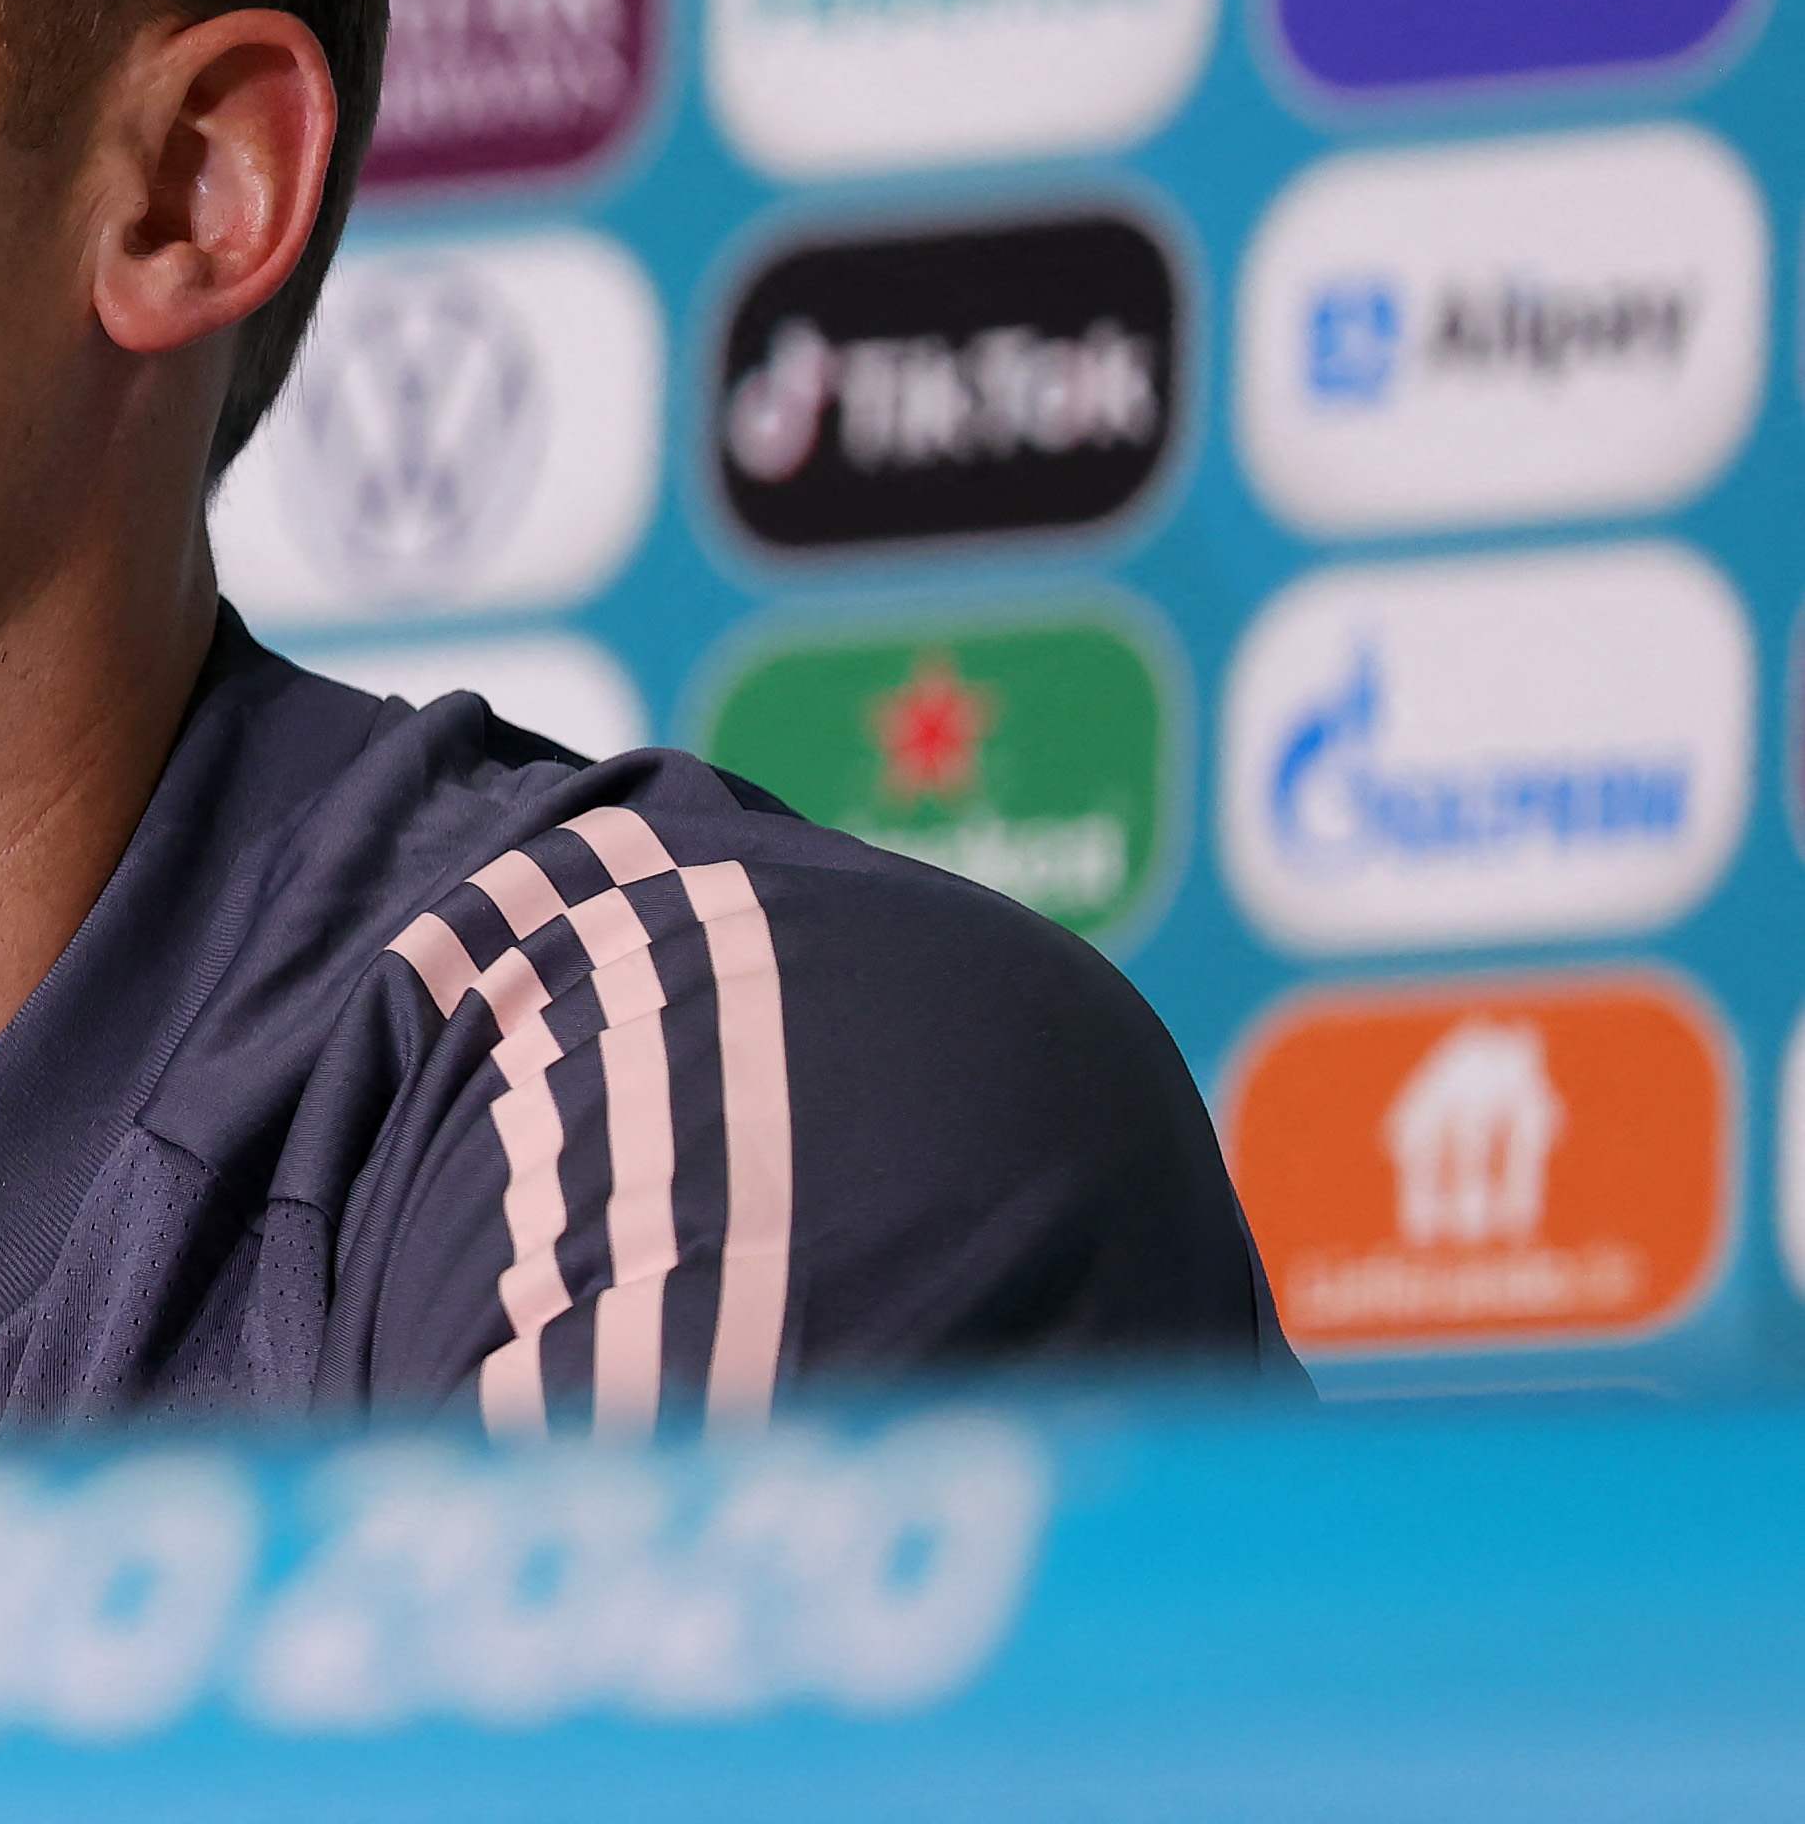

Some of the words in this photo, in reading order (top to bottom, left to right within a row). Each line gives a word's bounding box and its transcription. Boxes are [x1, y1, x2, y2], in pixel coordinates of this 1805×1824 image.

[843, 326, 1149, 465] TikTok
[1431, 282, 1685, 386] Alipay
[249, 1416, 1043, 1724] 2020
